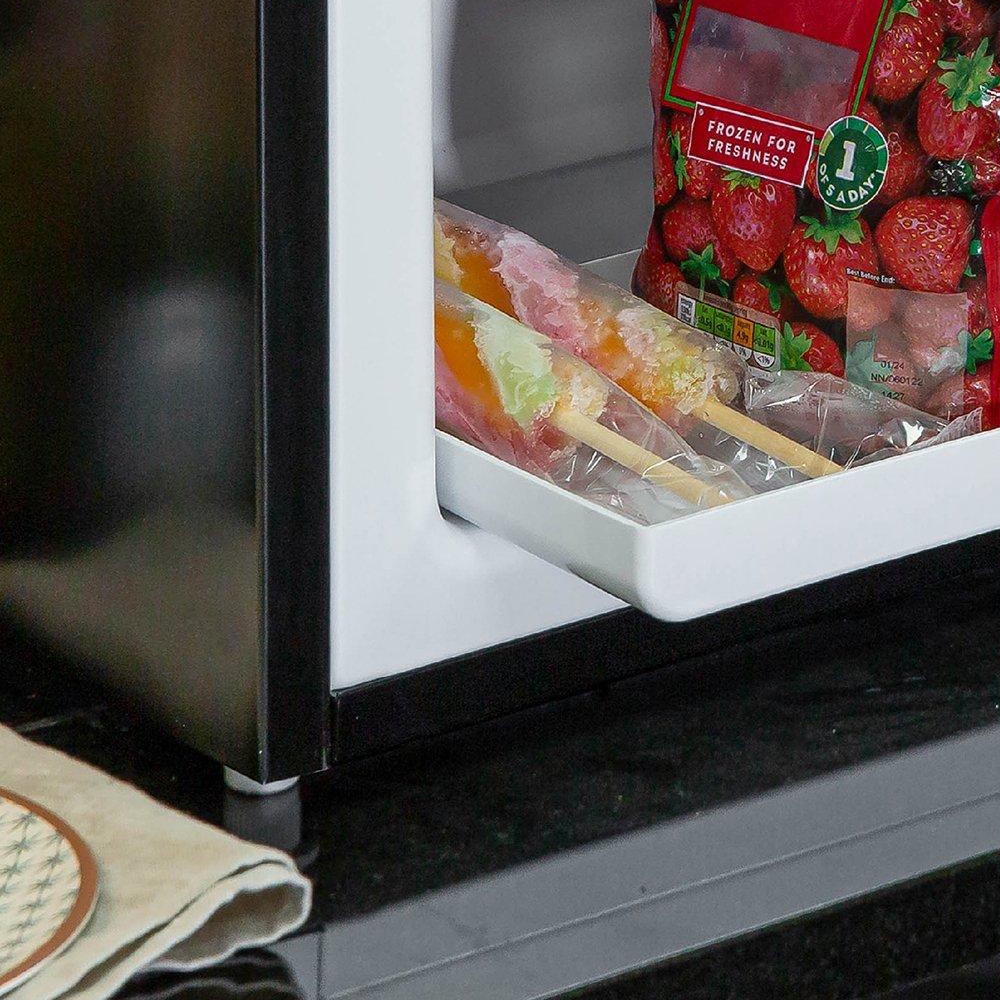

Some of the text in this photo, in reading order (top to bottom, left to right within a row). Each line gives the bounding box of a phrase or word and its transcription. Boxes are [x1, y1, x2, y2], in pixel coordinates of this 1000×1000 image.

[707, 120, 797, 154] FROZEN FOR
[707, 138, 788, 170] FRESHNESS
[835, 140, 857, 181] 1
[819, 163, 830, 184] OF
[836, 190, 847, 204] A
[846, 267, 860, 277] Best
[860, 270, 881, 282] Before
